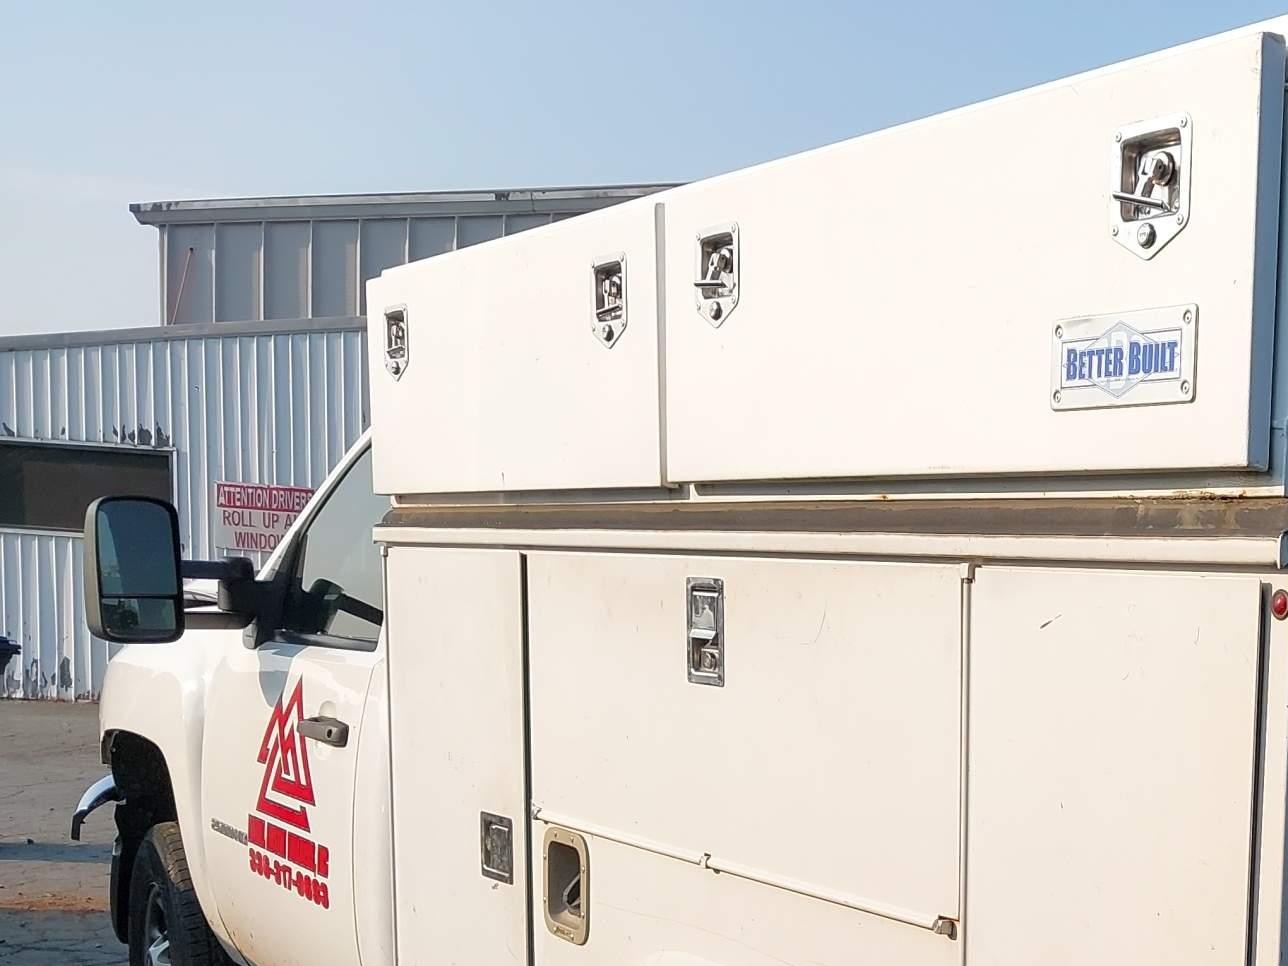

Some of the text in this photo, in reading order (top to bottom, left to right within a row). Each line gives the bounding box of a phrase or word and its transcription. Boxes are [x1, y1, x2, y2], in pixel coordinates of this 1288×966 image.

[1066, 339, 1178, 382] BETTER BUILT
[218, 486, 270, 509] ATTENTION
[223, 510, 256, 527] ROLL
[263, 512, 280, 528] UP
